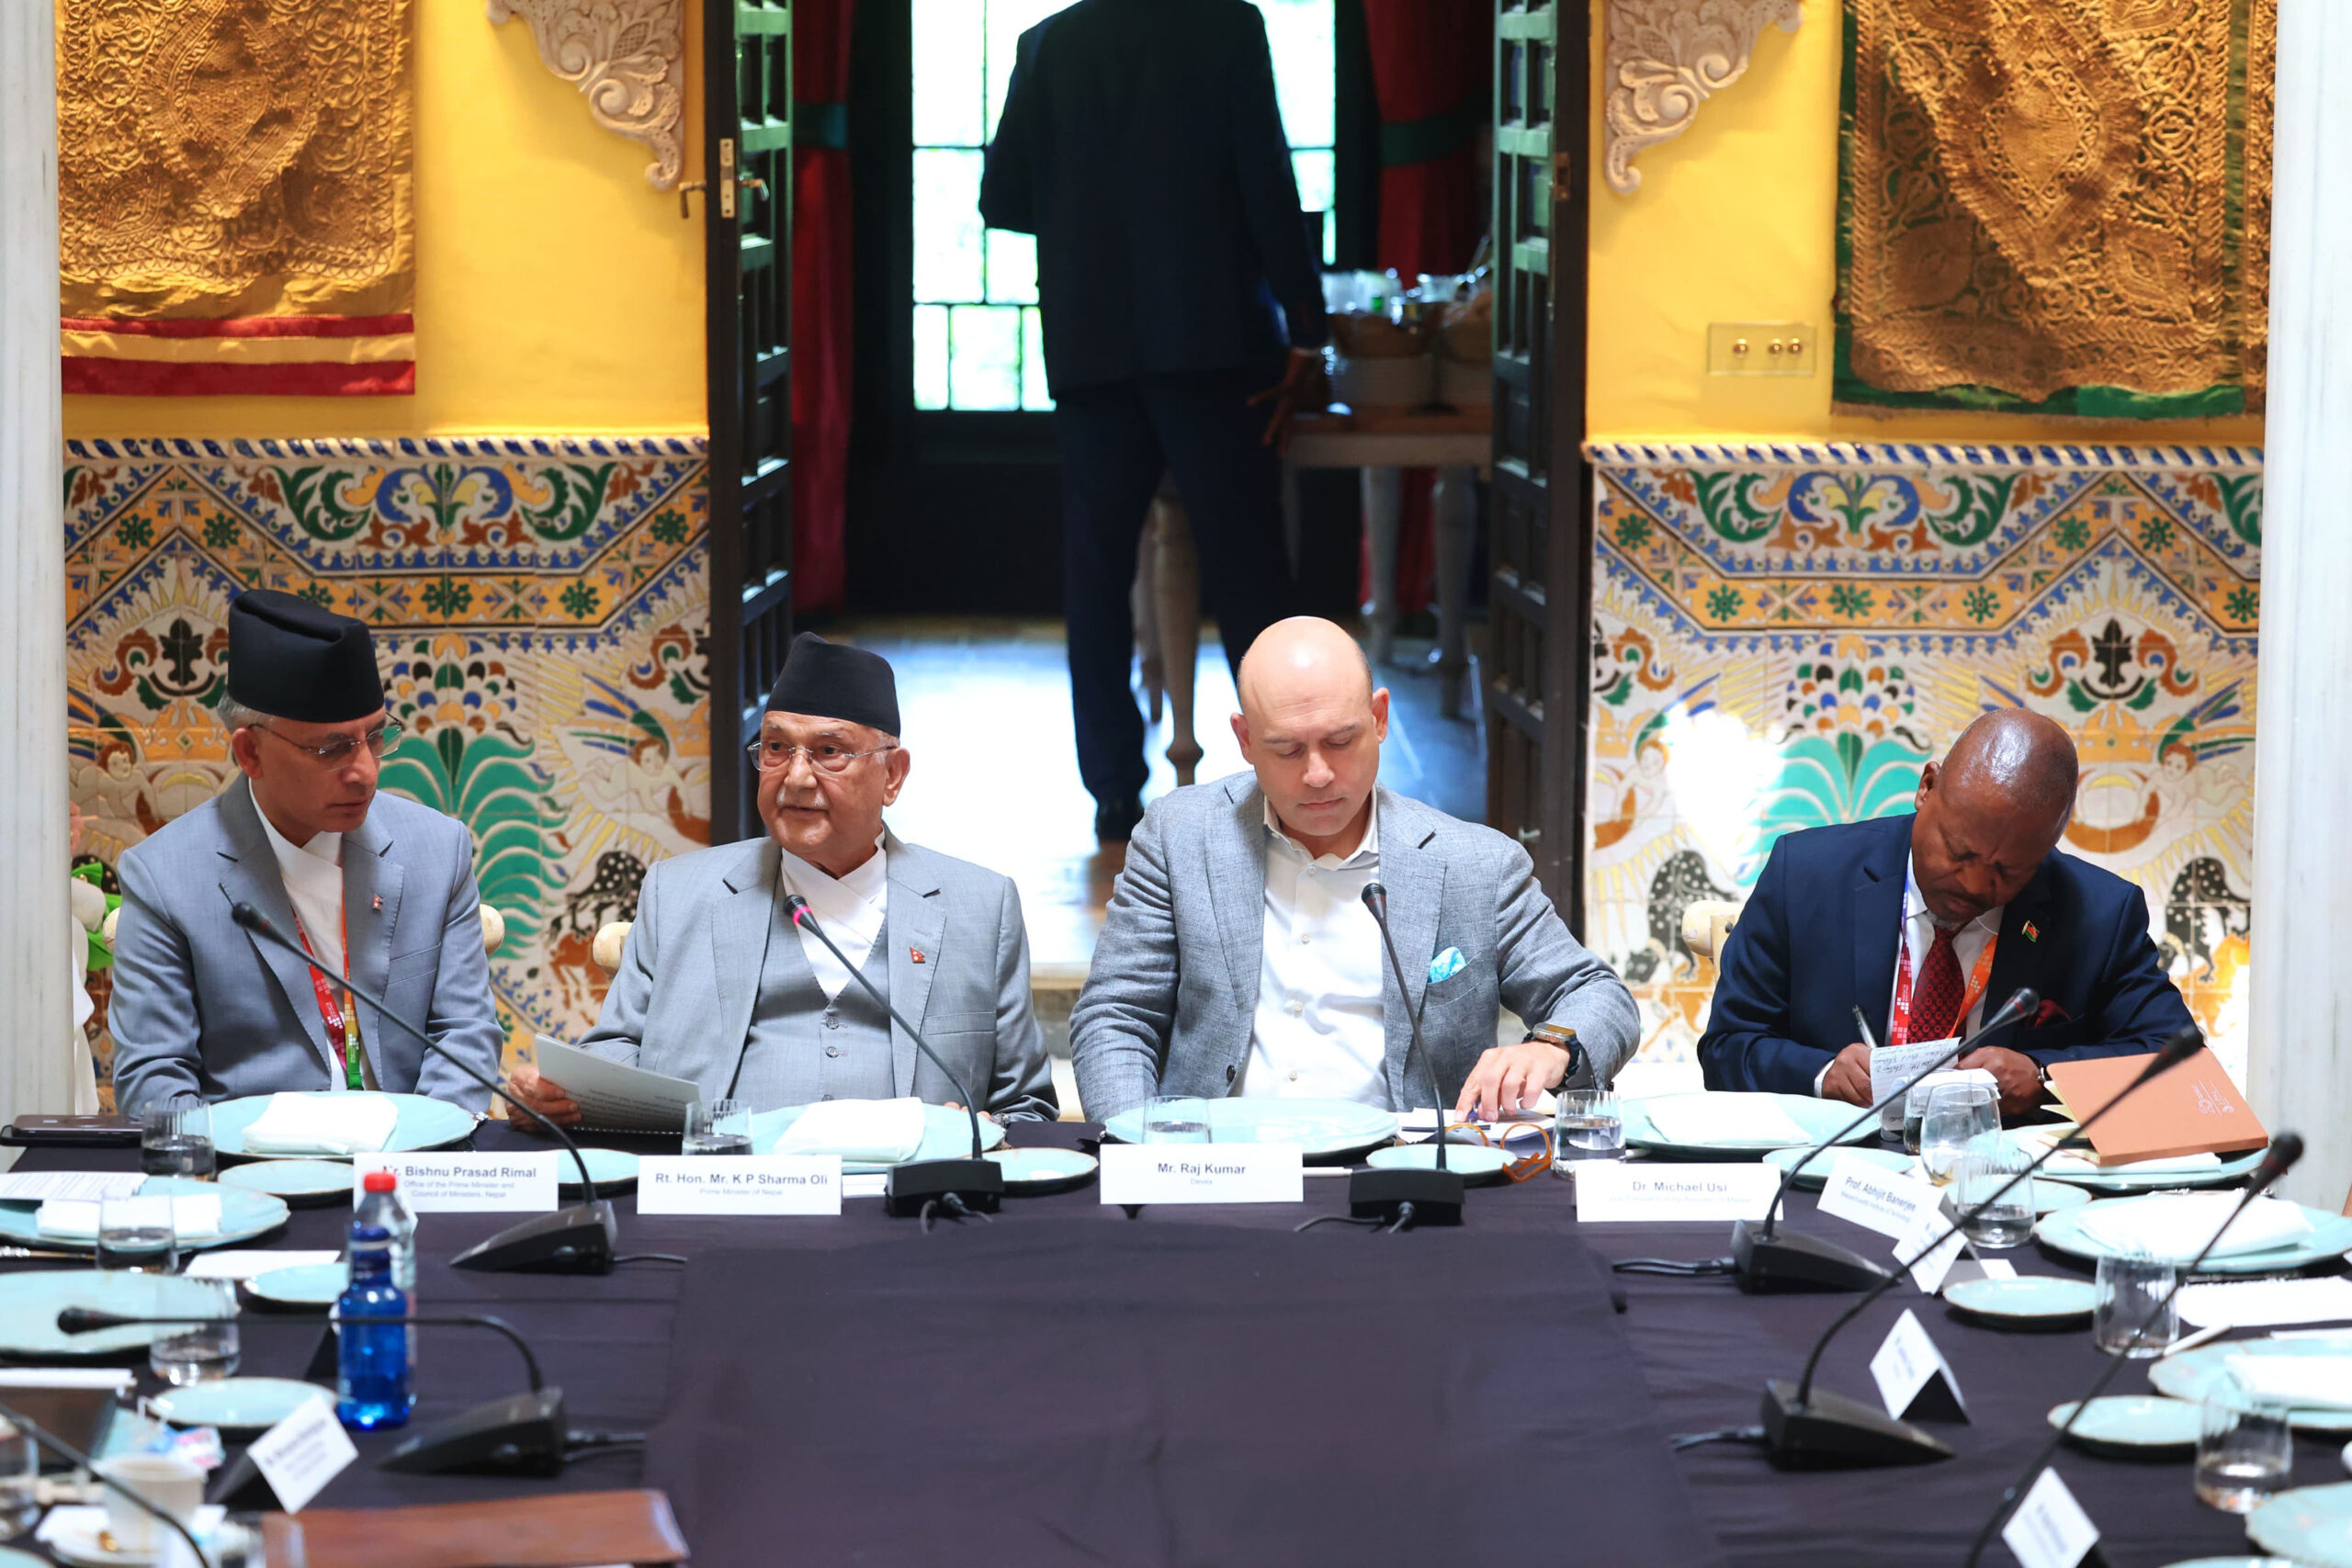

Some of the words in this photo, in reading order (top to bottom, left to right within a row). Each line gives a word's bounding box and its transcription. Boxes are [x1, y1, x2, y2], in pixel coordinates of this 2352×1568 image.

[405, 1166, 450, 1177] Bishnu
[454, 1166, 498, 1178] Prasad
[501, 1167, 537, 1178] Rimal
[1158, 1162, 1177, 1173] Mr.
[1181, 1162, 1201, 1176] Raj
[1204, 1164, 1247, 1175] Kumar
[655, 1172, 673, 1183] Rt.
[676, 1173, 706, 1183] Hon.
[709, 1173, 729, 1183] Mr.
[733, 1173, 742, 1183] K
[745, 1173, 754, 1183] P
[758, 1173, 807, 1184] Sharma
[809, 1174, 828, 1184] Oli
[1845, 1176, 1862, 1190] Prof.
[1654, 1180, 1703, 1191] Michael
[1706, 1182, 1728, 1192] Usi
